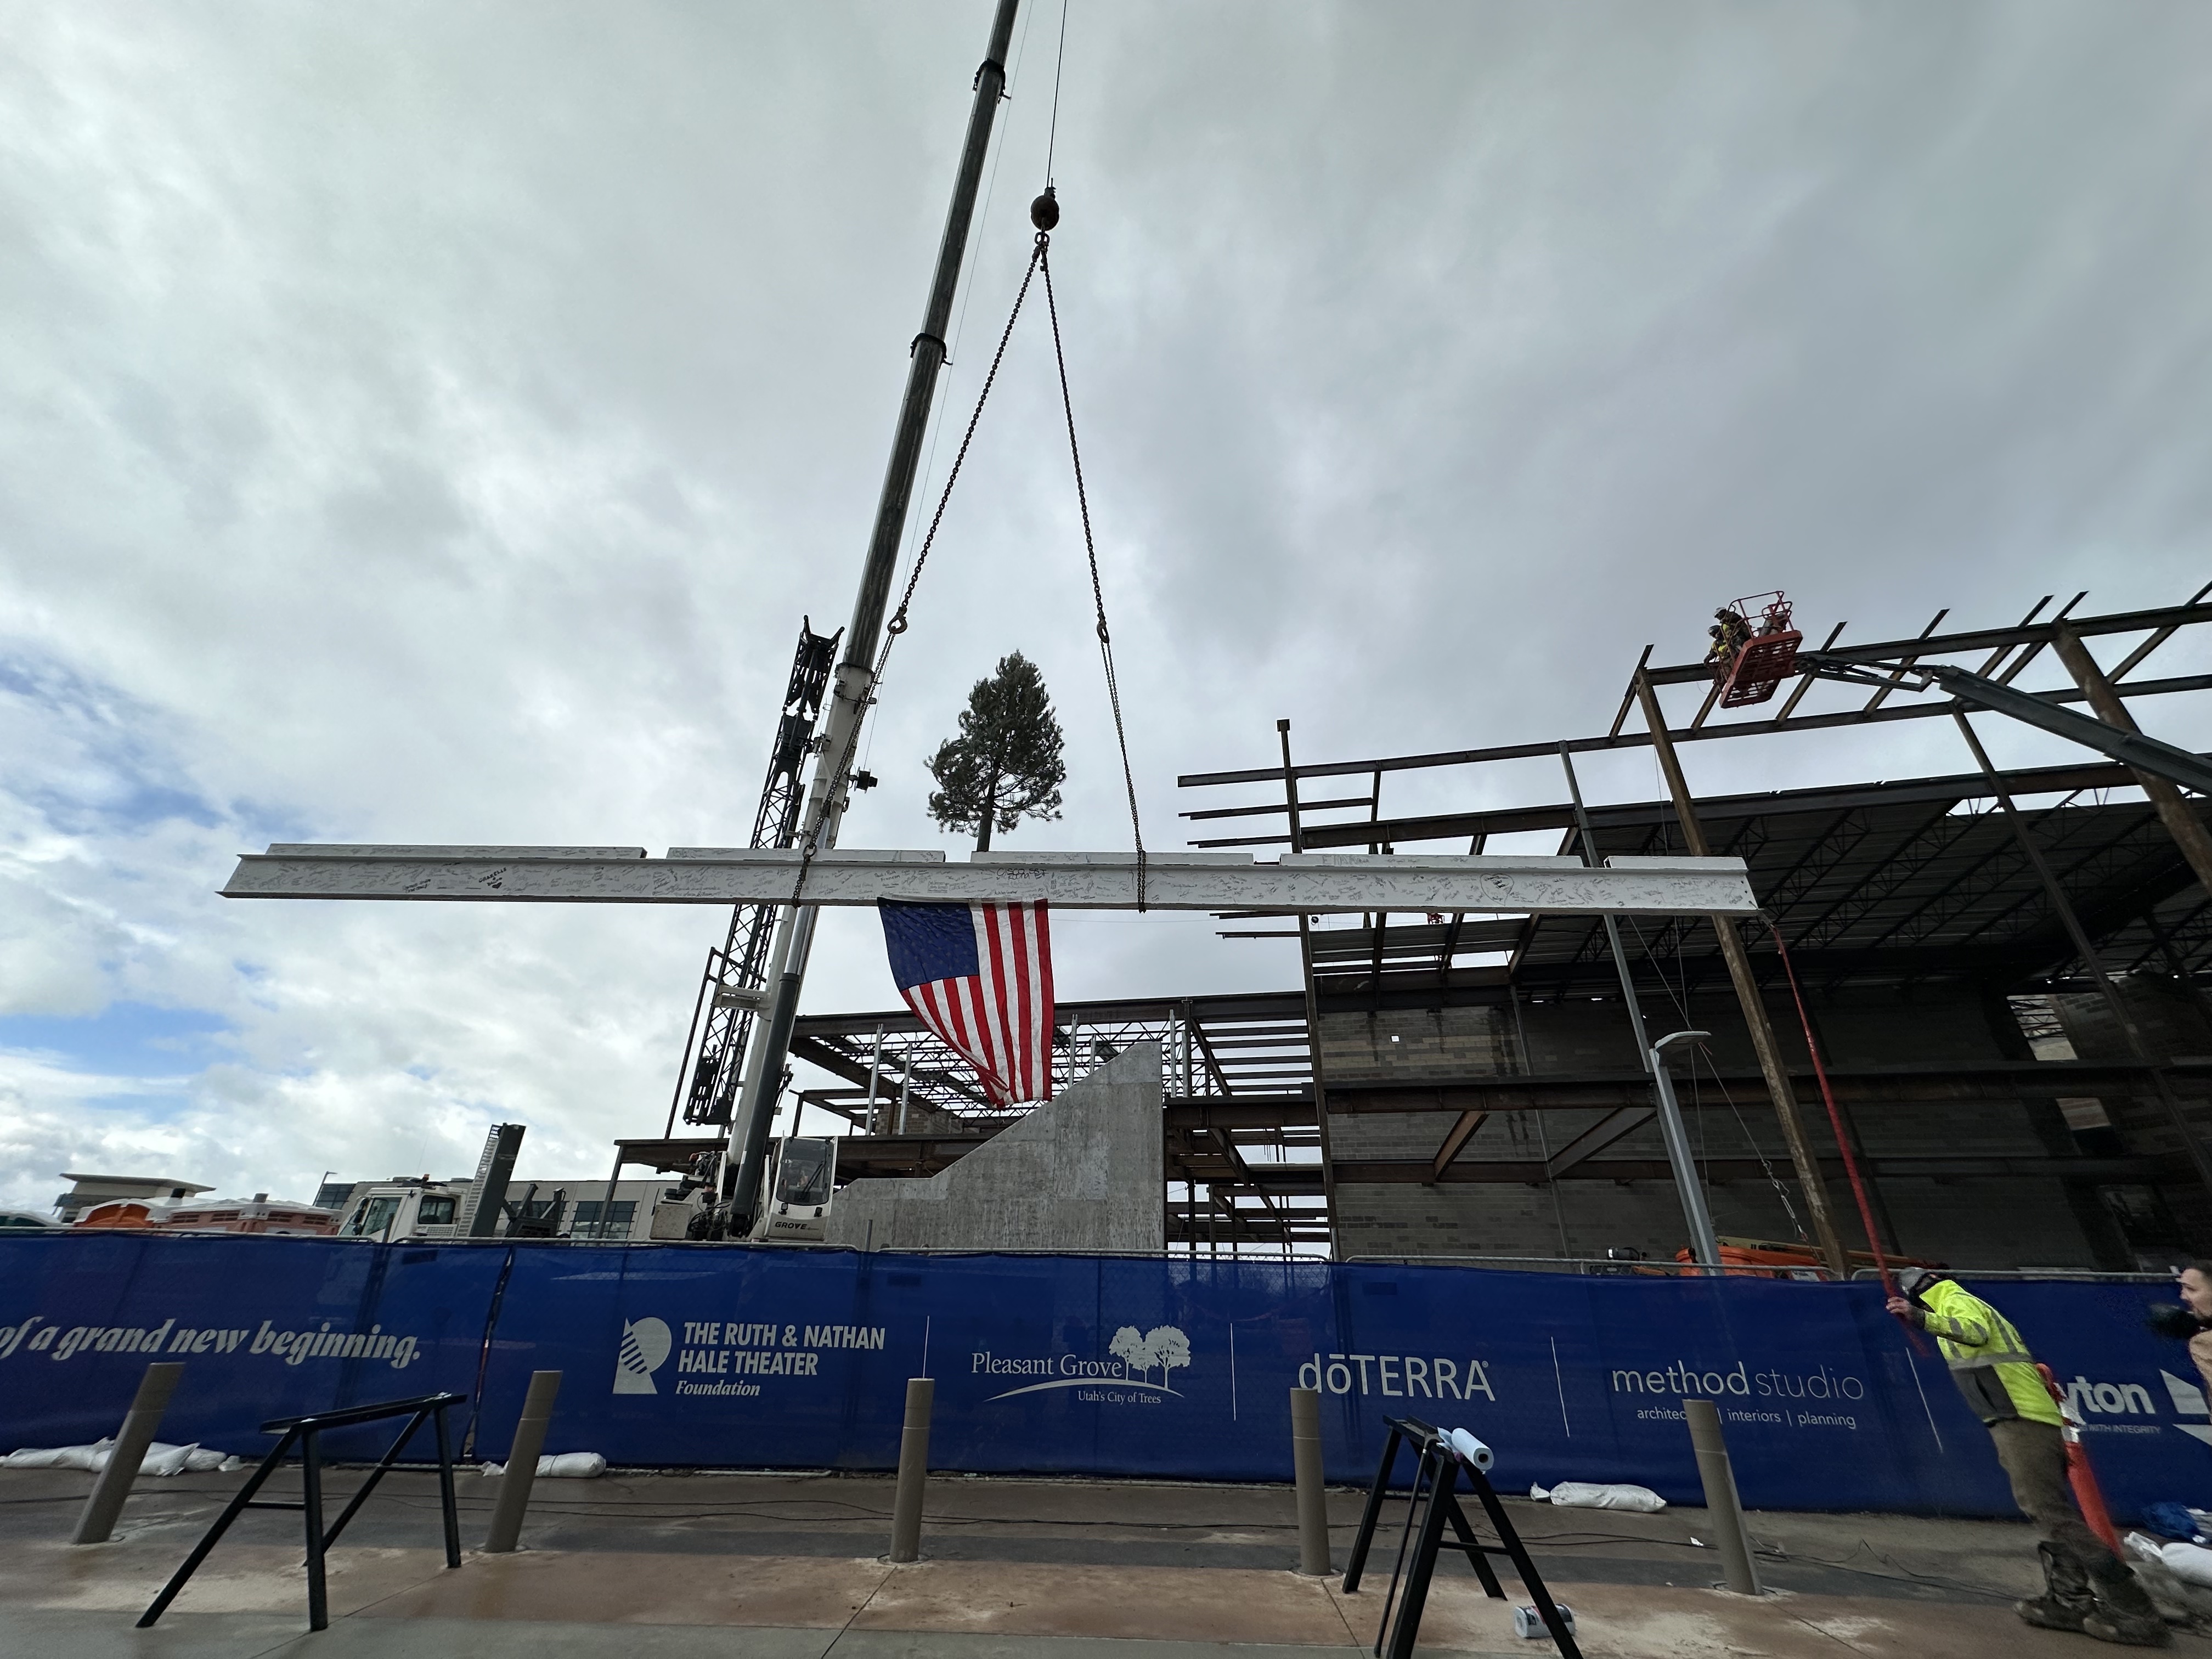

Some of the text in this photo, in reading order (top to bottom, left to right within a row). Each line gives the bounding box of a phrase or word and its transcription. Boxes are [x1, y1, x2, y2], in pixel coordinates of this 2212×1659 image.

[775, 1221, 808, 1229] GROVE
[0, 1316, 421, 1369] of a grand new beginning.
[684, 1322, 885, 1350] THE RUTH & NATHAN
[678, 1350, 818, 1375] HALE THEATER
[971, 1351, 1122, 1377] Pleasant Grove
[675, 1379, 760, 1396] Foundation
[1612, 1359, 1864, 1400] method studio
[1078, 1390, 1161, 1406] Utah's City of Trees
[2053, 1375, 2156, 1415] yton
[1637, 1406, 1856, 1430] architec interiors planning
[2088, 1424, 2111, 1432] WITH
[2113, 1425, 2160, 1434] INTEGRITY
